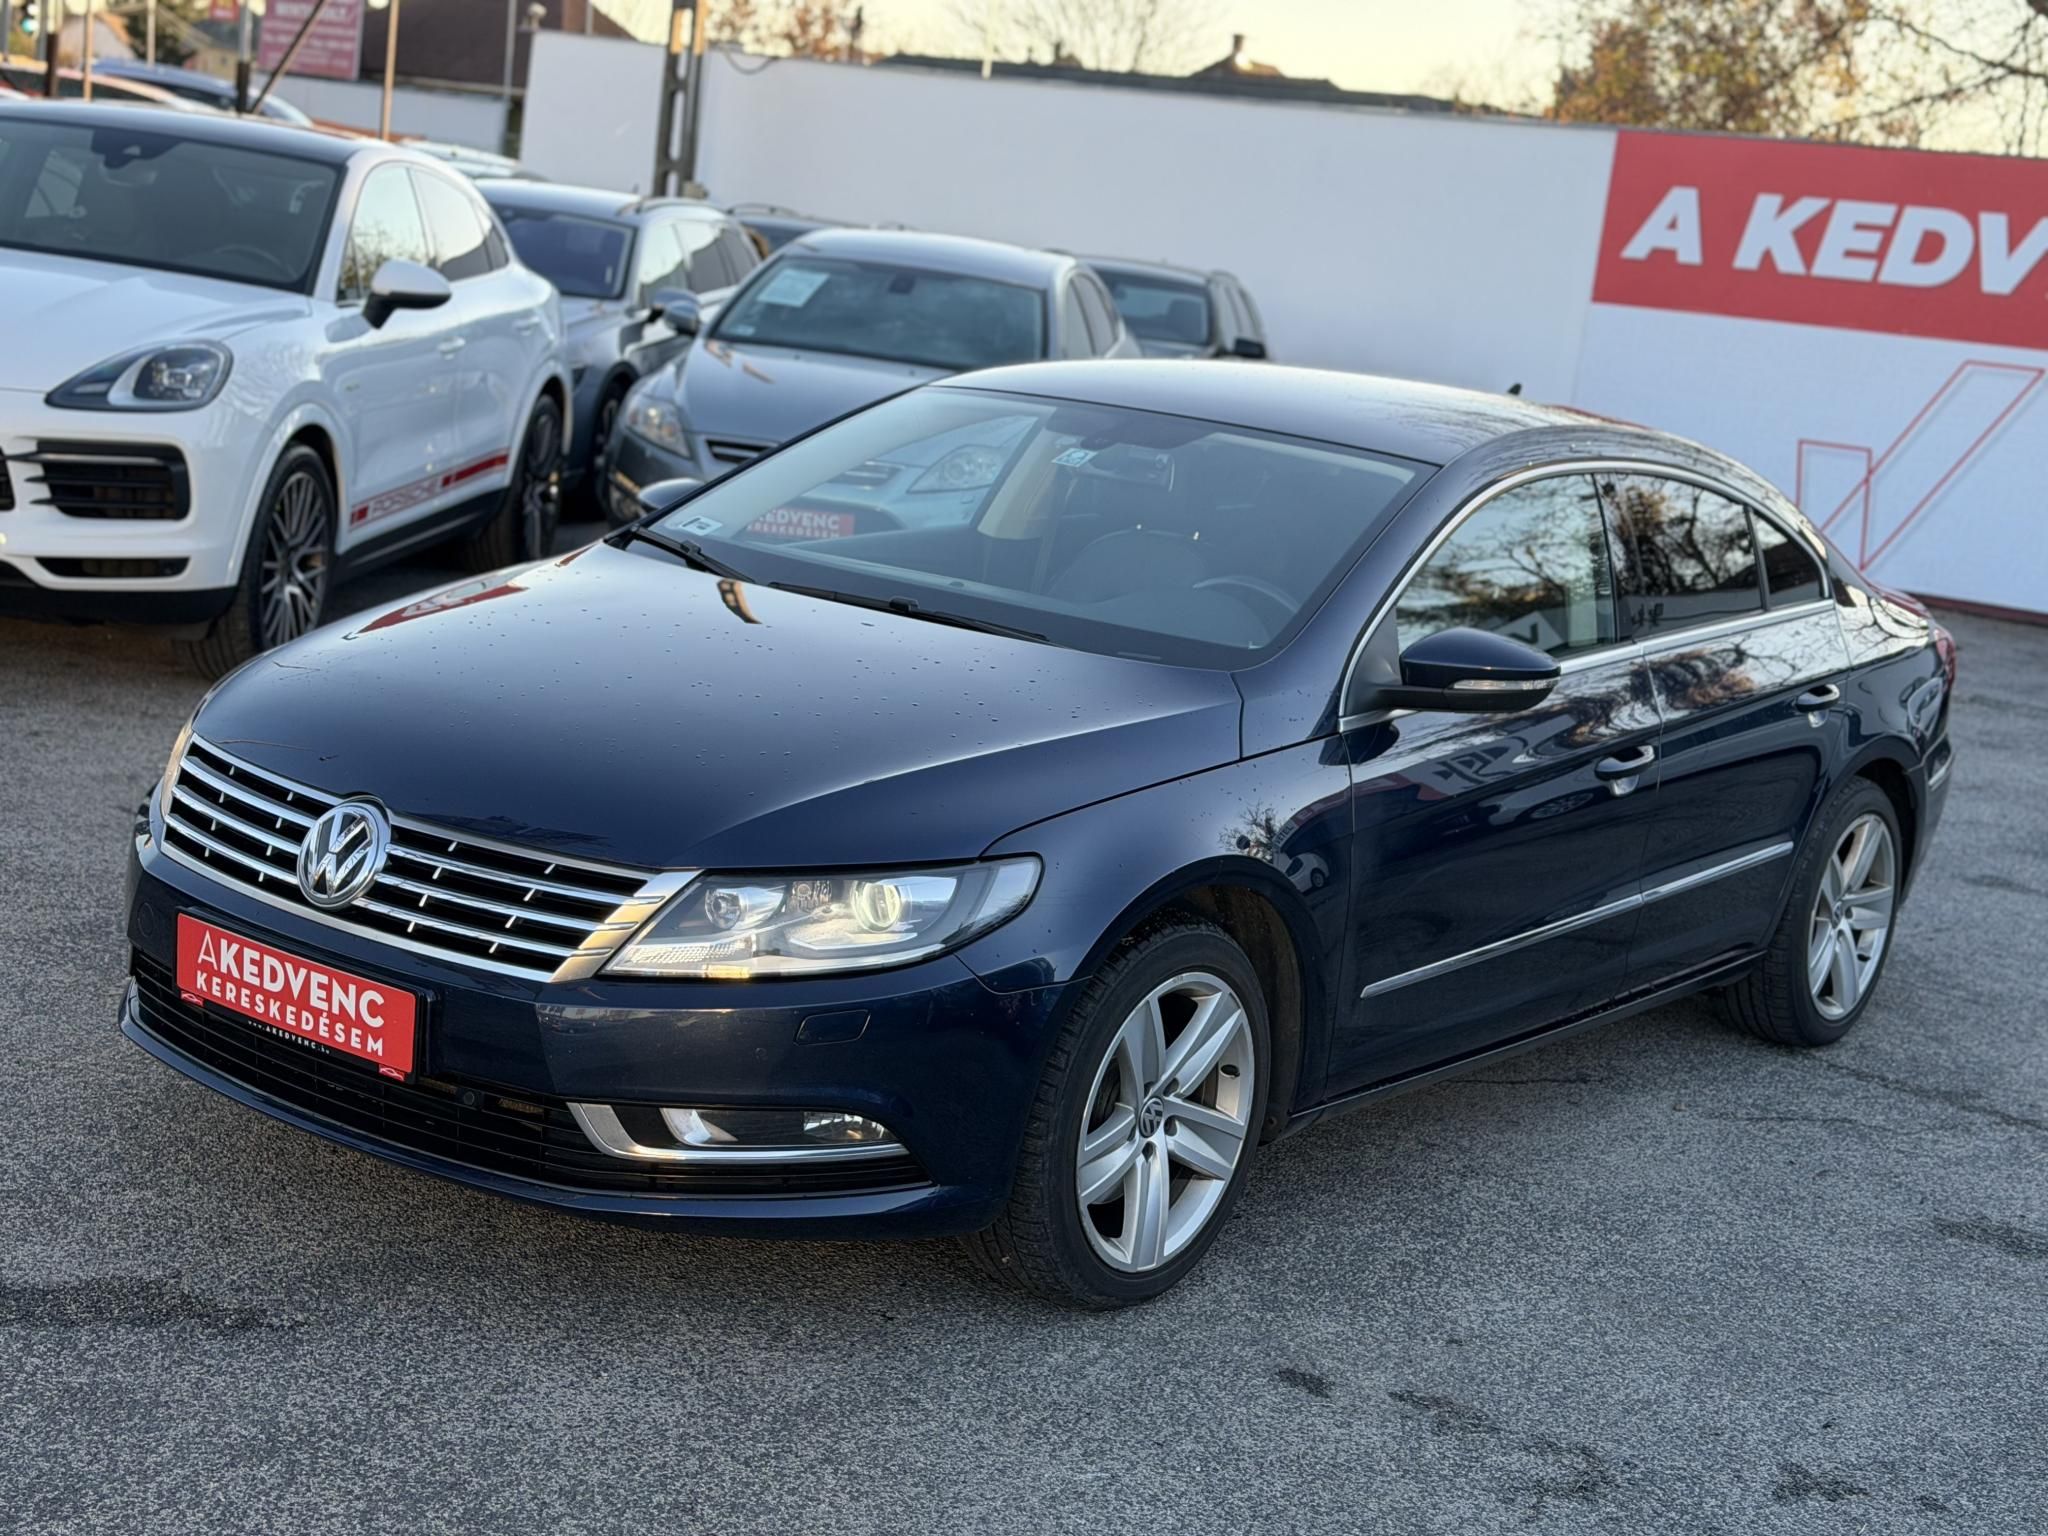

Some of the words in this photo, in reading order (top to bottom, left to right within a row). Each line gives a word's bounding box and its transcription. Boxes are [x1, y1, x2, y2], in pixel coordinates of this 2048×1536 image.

[1620, 186, 1702, 266] A
[1731, 192, 2048, 295] KEDV
[196, 970, 384, 1057] KERESKEDÉSEM
